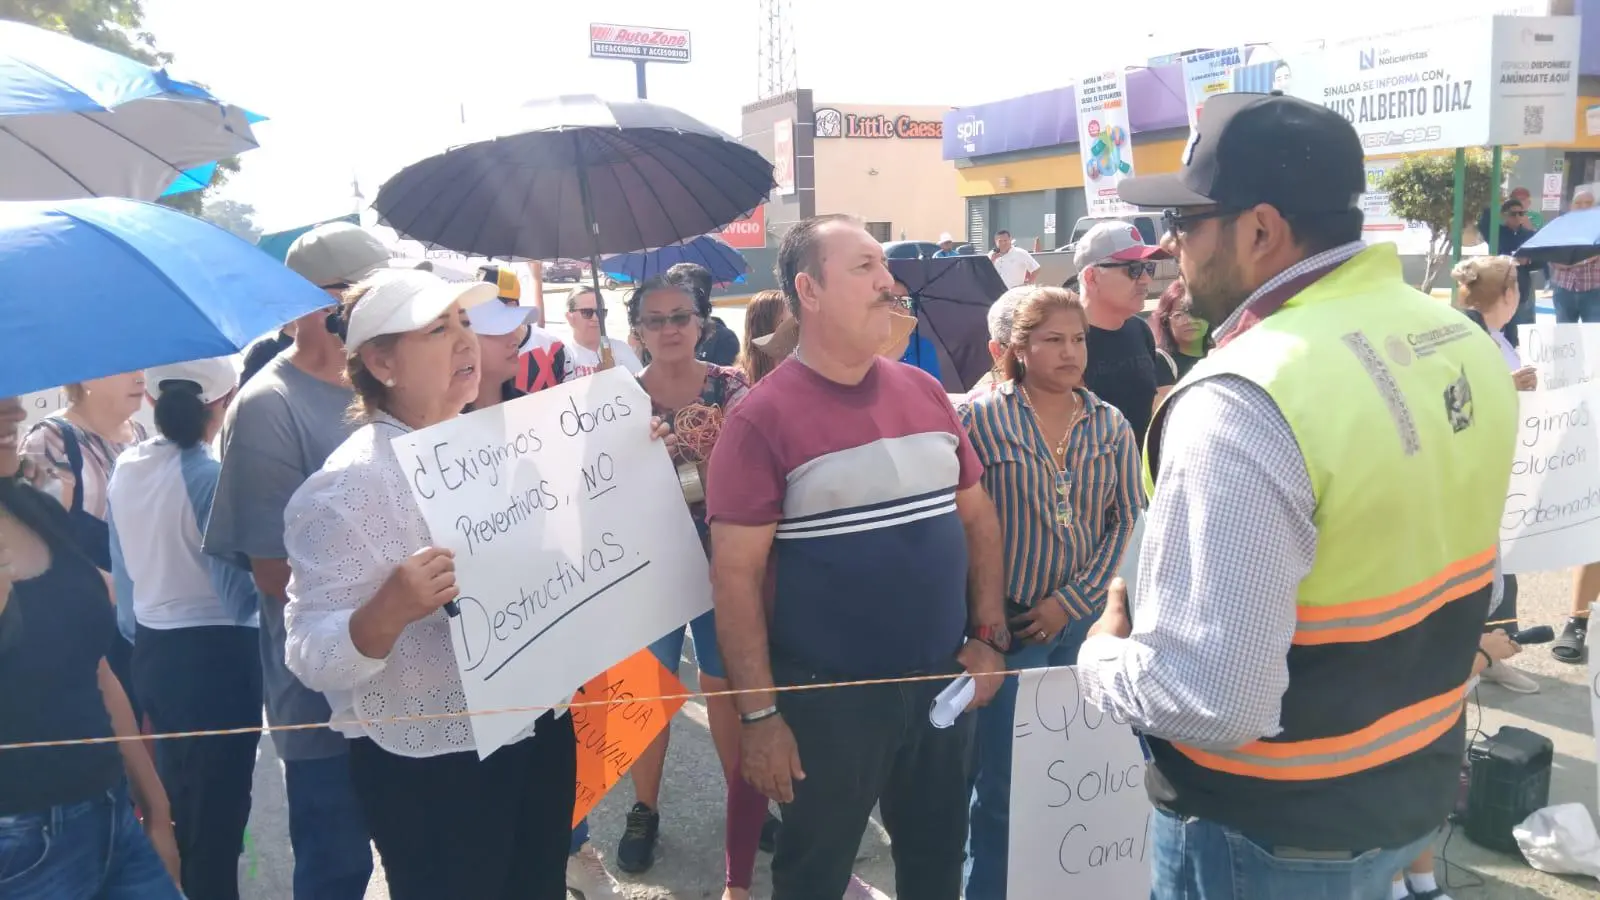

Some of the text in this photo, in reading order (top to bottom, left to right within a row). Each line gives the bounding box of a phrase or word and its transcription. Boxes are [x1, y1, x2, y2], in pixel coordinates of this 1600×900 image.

[595, 44, 688, 58] REFACCIONES Y ACCESORIOS
[616, 29, 687, 47] AutoZone
[1379, 51, 1429, 66] Noticieristas
[1324, 69, 1444, 97] SINALOA SE INFORMA CON
[1549, 71, 1571, 83] AQUÍ
[1359, 87, 1428, 124] ALBERTO
[1433, 74, 1473, 114] DÍAZ
[846, 113, 943, 138] Little Caesa
[957, 119, 984, 141] spin
[560, 395, 632, 437] obras
[456, 452, 614, 556] Preventivas, NO
[1048, 760, 1140, 808] Soluc
[1059, 812, 1150, 875] Canal
